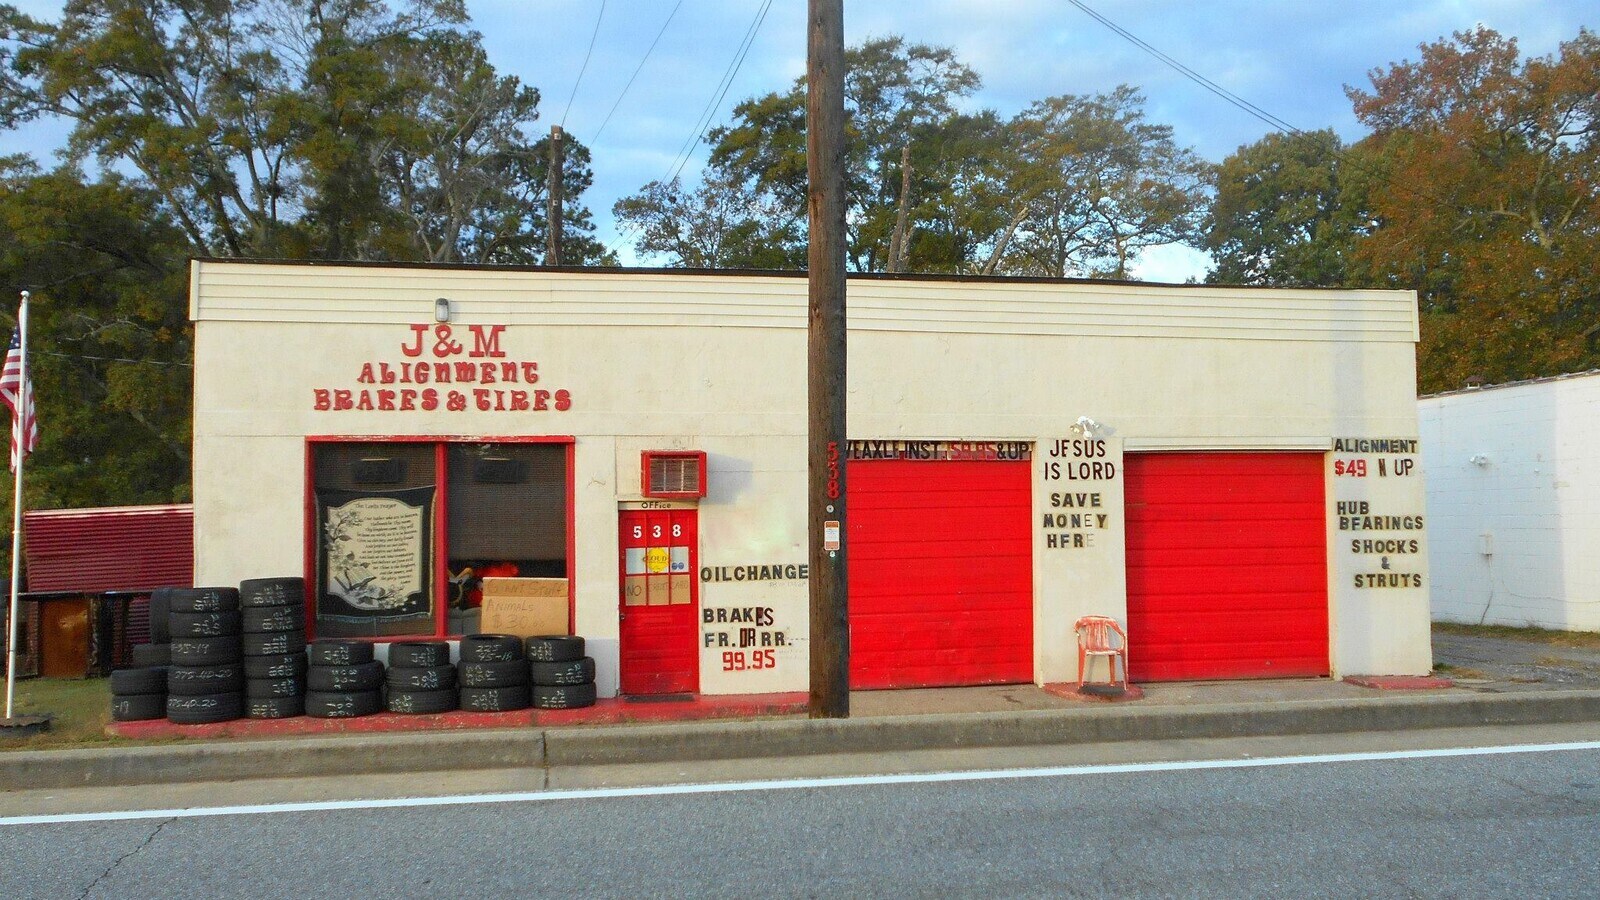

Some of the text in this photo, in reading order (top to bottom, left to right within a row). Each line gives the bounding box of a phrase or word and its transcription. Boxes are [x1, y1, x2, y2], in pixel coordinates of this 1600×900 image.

[401, 324, 506, 358] J&M
[313, 388, 572, 412] BRAKES & TIRES
[1334, 438, 1418, 454] ALIGNMENT
[1044, 462, 1115, 481] IS LORD
[1334, 459, 1367, 477] $49
[1394, 458, 1414, 476] UP
[1051, 493, 1101, 508] SAVE
[1337, 501, 1370, 515] HUB
[1043, 513, 1107, 528] MONEY
[1352, 539, 1418, 554] SHOCKS
[1381, 556, 1390, 570] &
[1354, 573, 1422, 588] STRUTS
[703, 607, 774, 627] BRAKES
[722, 649, 776, 672] 99.95
